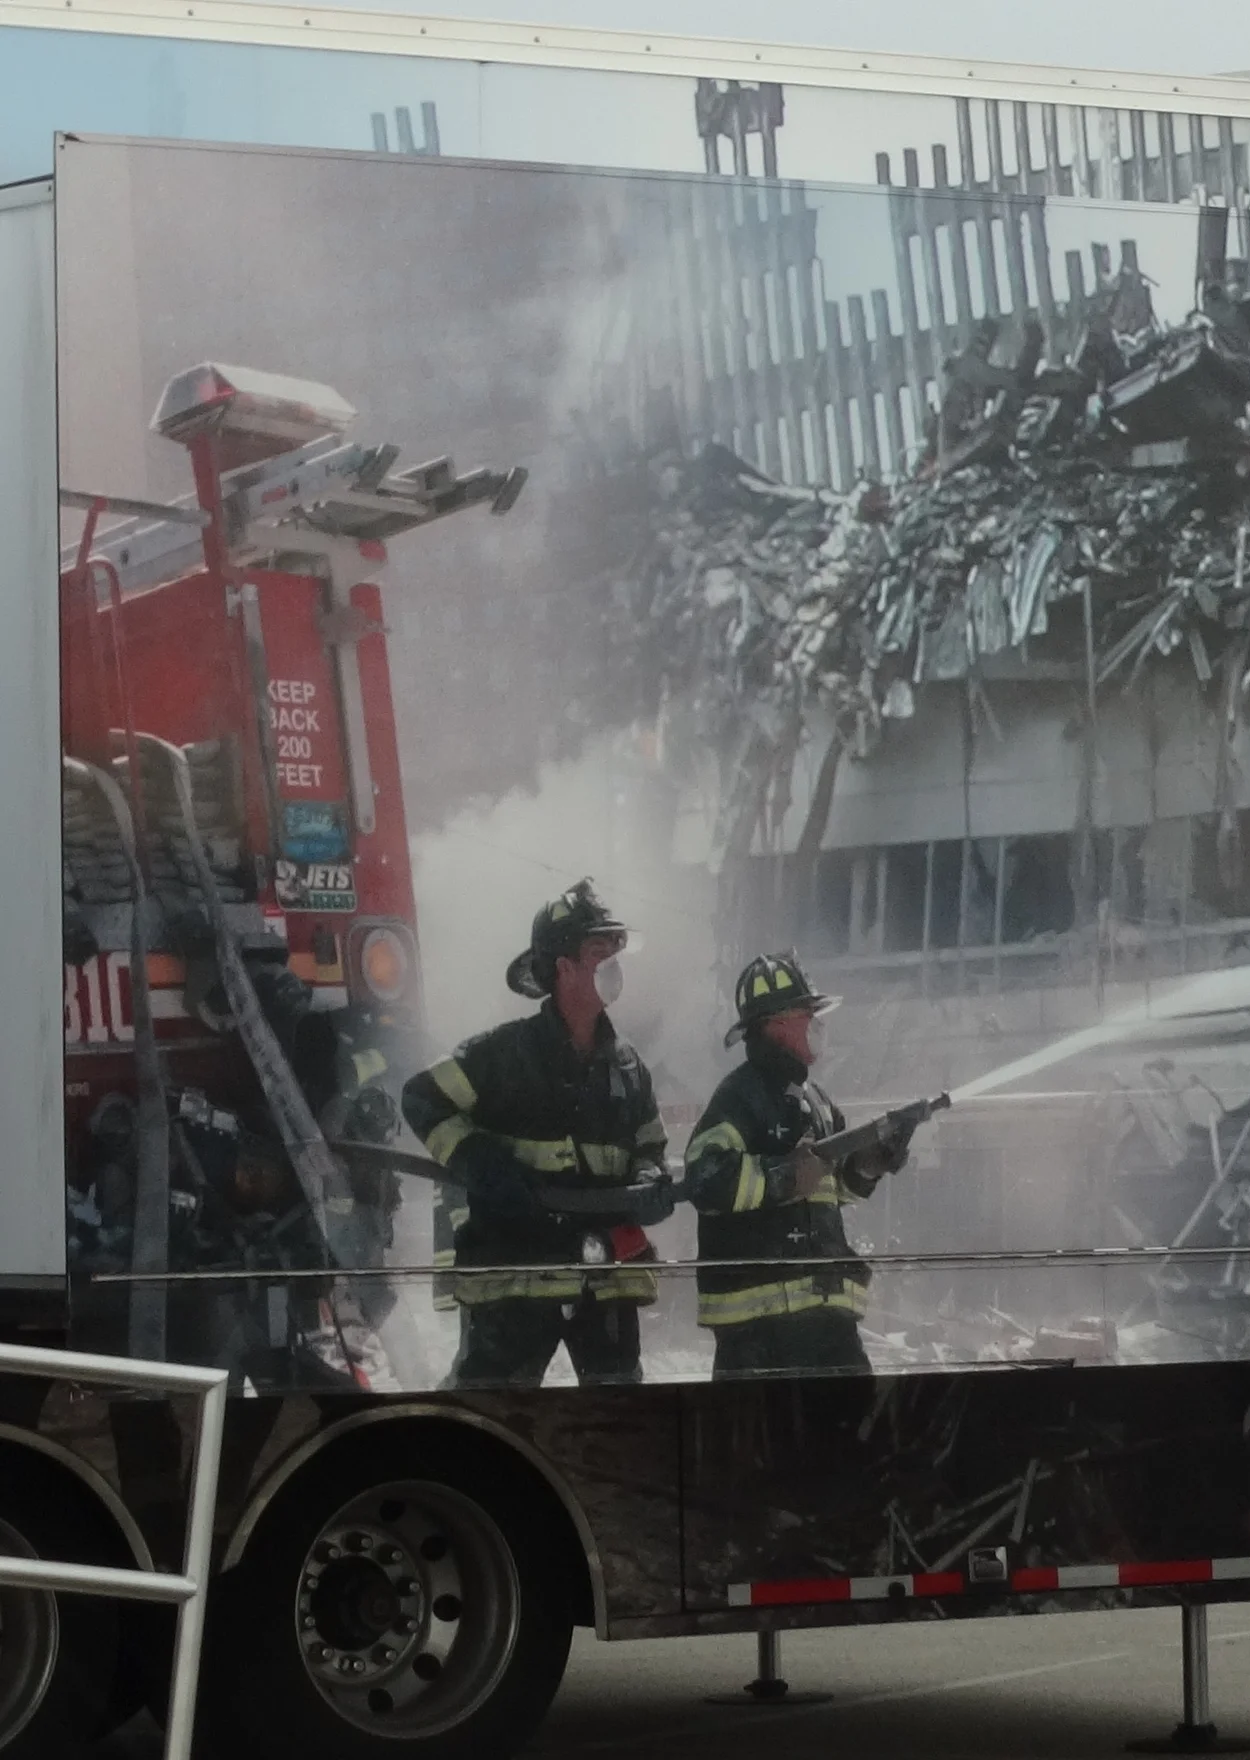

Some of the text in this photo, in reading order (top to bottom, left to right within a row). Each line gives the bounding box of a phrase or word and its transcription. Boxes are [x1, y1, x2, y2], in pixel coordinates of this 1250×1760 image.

[277, 736, 312, 759] 200
[275, 763, 323, 788] FEET
[301, 864, 350, 889] JETS
